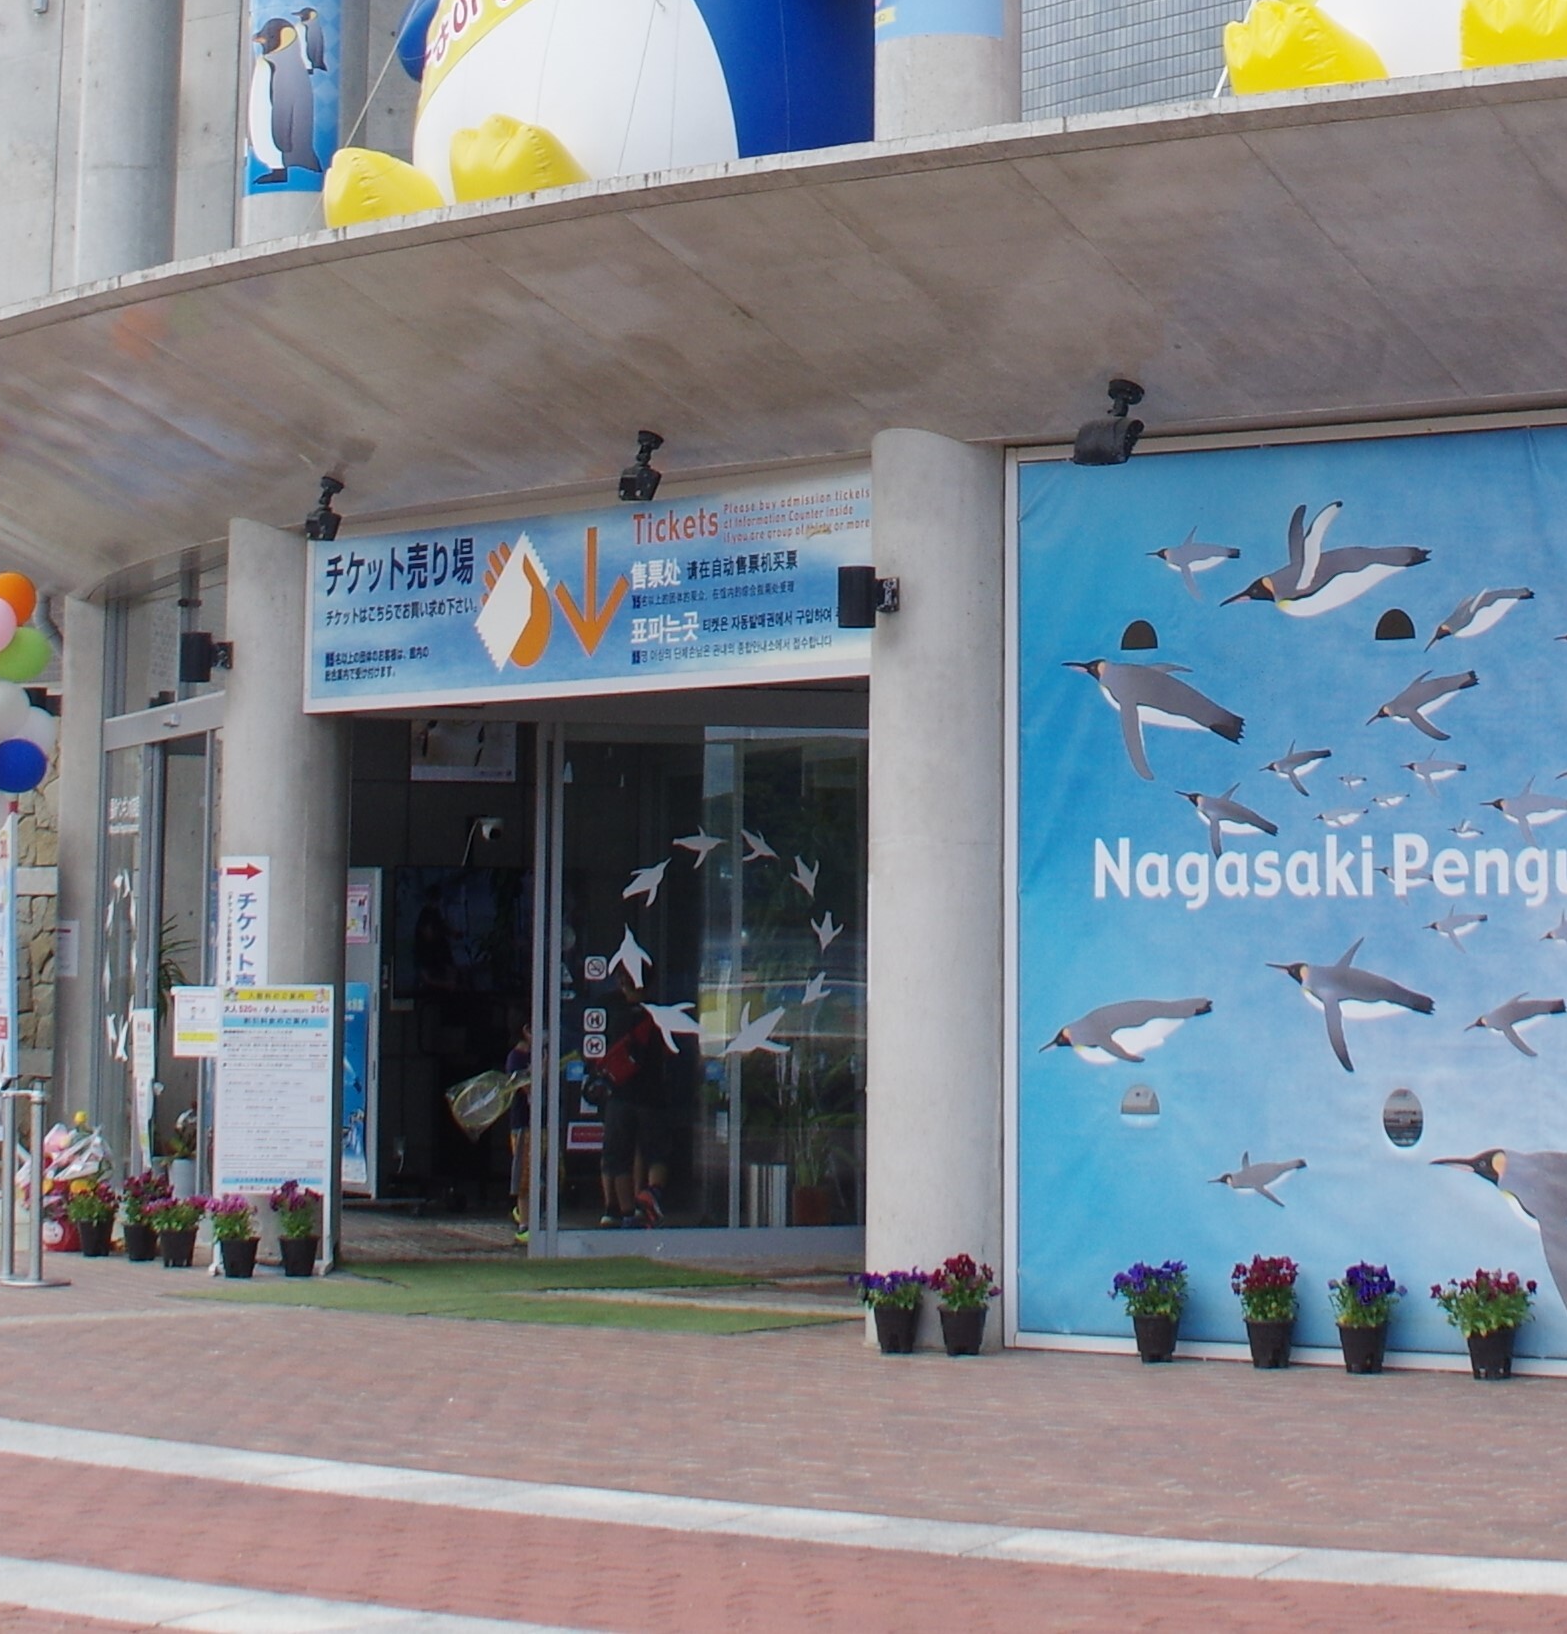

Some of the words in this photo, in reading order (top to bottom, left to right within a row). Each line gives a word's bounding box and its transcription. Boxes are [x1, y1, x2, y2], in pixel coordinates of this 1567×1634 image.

[723, 502, 756, 514] Please
[759, 498, 776, 512] buy
[780, 491, 831, 509] admission
[834, 487, 870, 501] tickets
[734, 513, 786, 529] Information
[788, 509, 824, 522] Counter
[825, 504, 854, 517] inside
[633, 507, 719, 545] Tickets
[834, 522, 845, 532] or
[847, 517, 871, 530] more
[326, 537, 475, 597] チケット売り場
[630, 557, 682, 591] 售票处
[686, 549, 798, 581] 请在自动售票机买票
[630, 610, 700, 645] 표파는곳
[702, 616, 728, 633] 티켓은
[1092, 833, 1375, 912] Nagasaki
